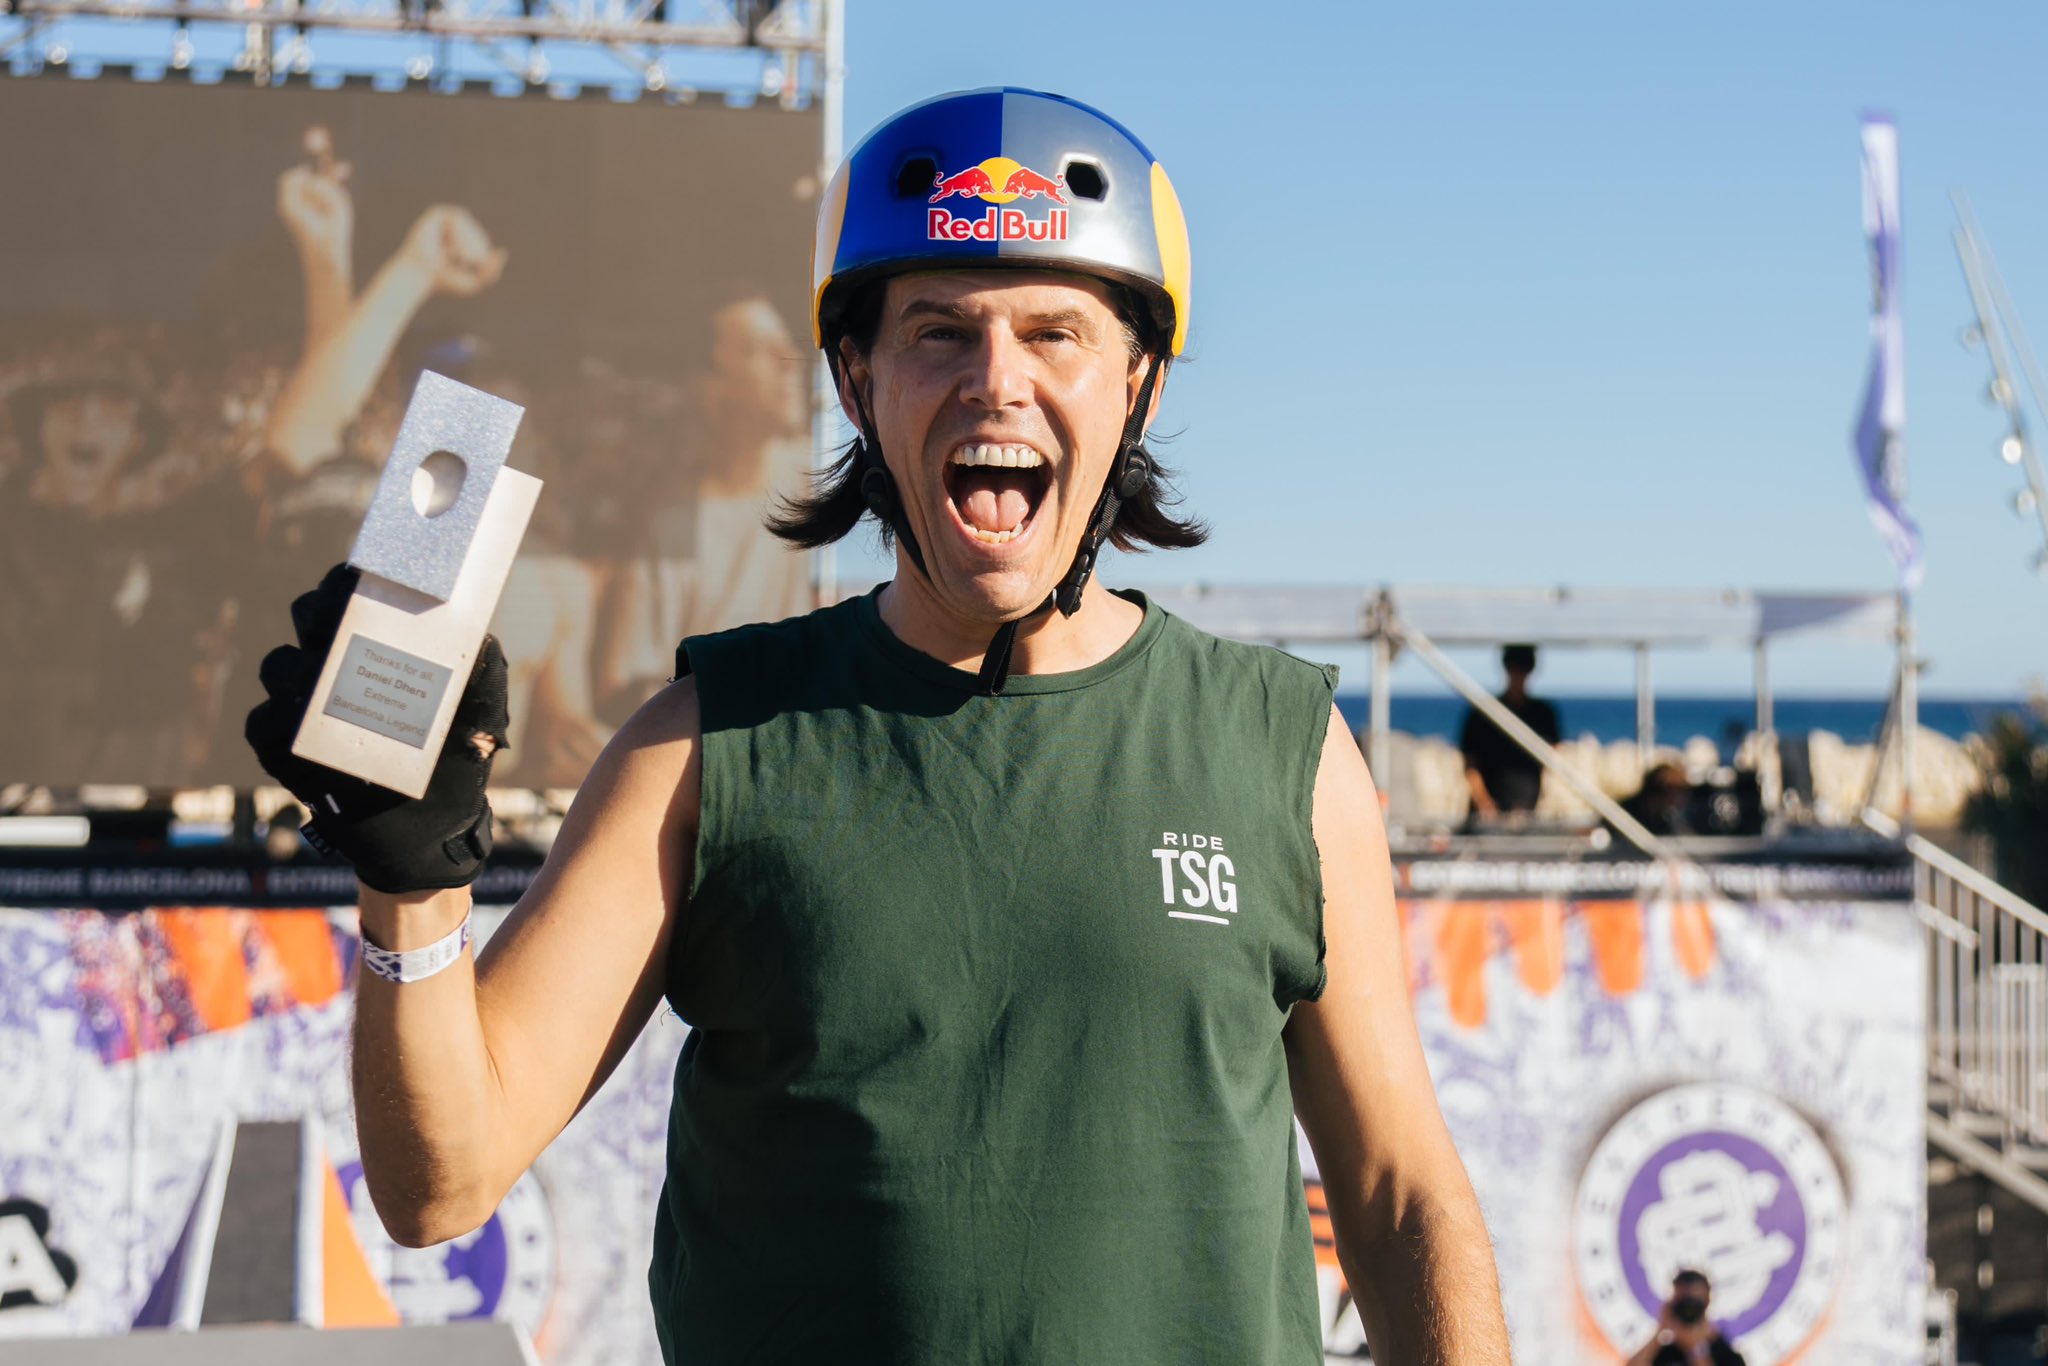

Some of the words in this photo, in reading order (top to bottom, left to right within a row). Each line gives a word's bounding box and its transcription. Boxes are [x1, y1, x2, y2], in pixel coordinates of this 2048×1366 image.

[928, 206, 998, 241] Red
[1001, 207, 1069, 241] Bull
[365, 648, 401, 670] Thanks
[402, 662, 418, 677] for
[355, 665, 393, 686] Daniel
[393, 679, 427, 699] Dhers
[363, 687, 408, 711] Extreme
[332, 695, 385, 722] Barcelona
[386, 716, 426, 737] Legend
[1163, 831, 1224, 851] RIDE
[1151, 848, 1238, 914] TSG
